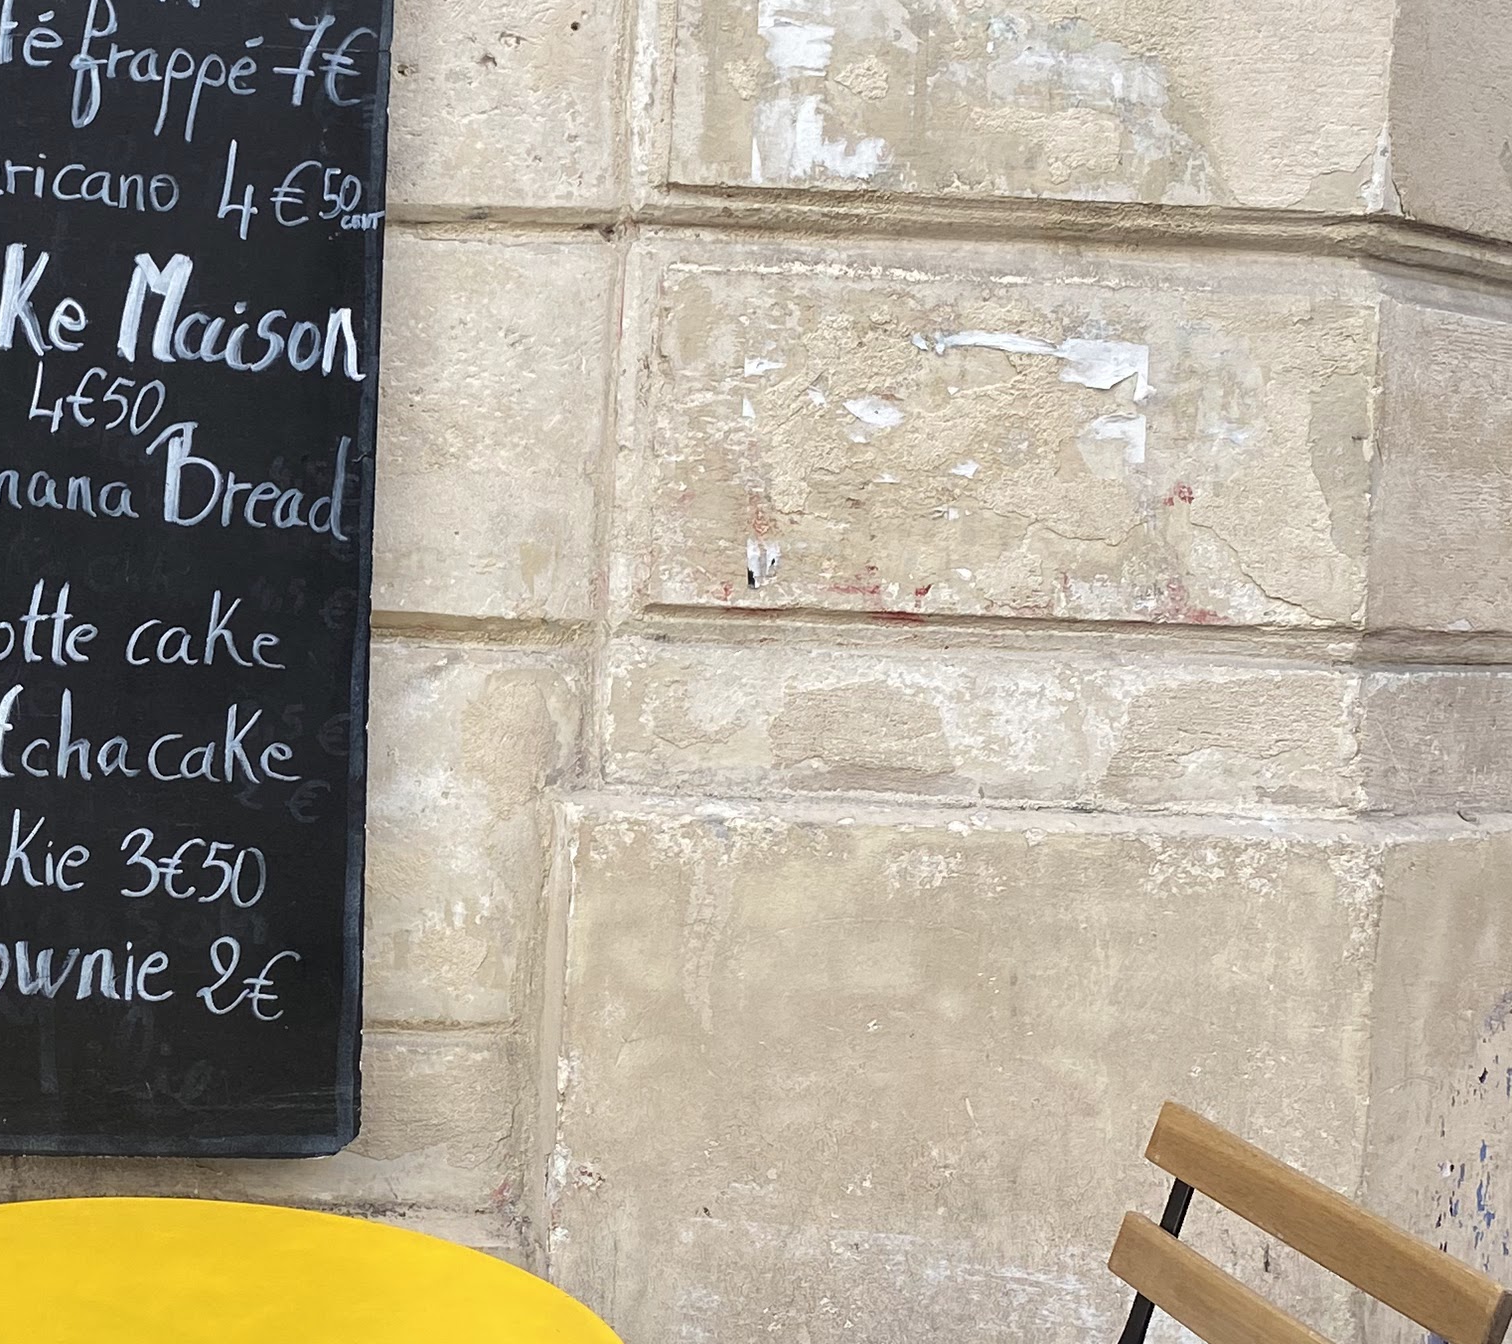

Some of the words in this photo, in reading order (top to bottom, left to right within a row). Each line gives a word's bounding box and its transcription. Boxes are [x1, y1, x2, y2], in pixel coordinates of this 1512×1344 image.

[117, 254, 365, 381] Maison
[29, 362, 167, 435] 4€50
[146, 421, 350, 542] Bread
[120, 827, 267, 908] 3€50
[196, 936, 301, 1022] 2€
